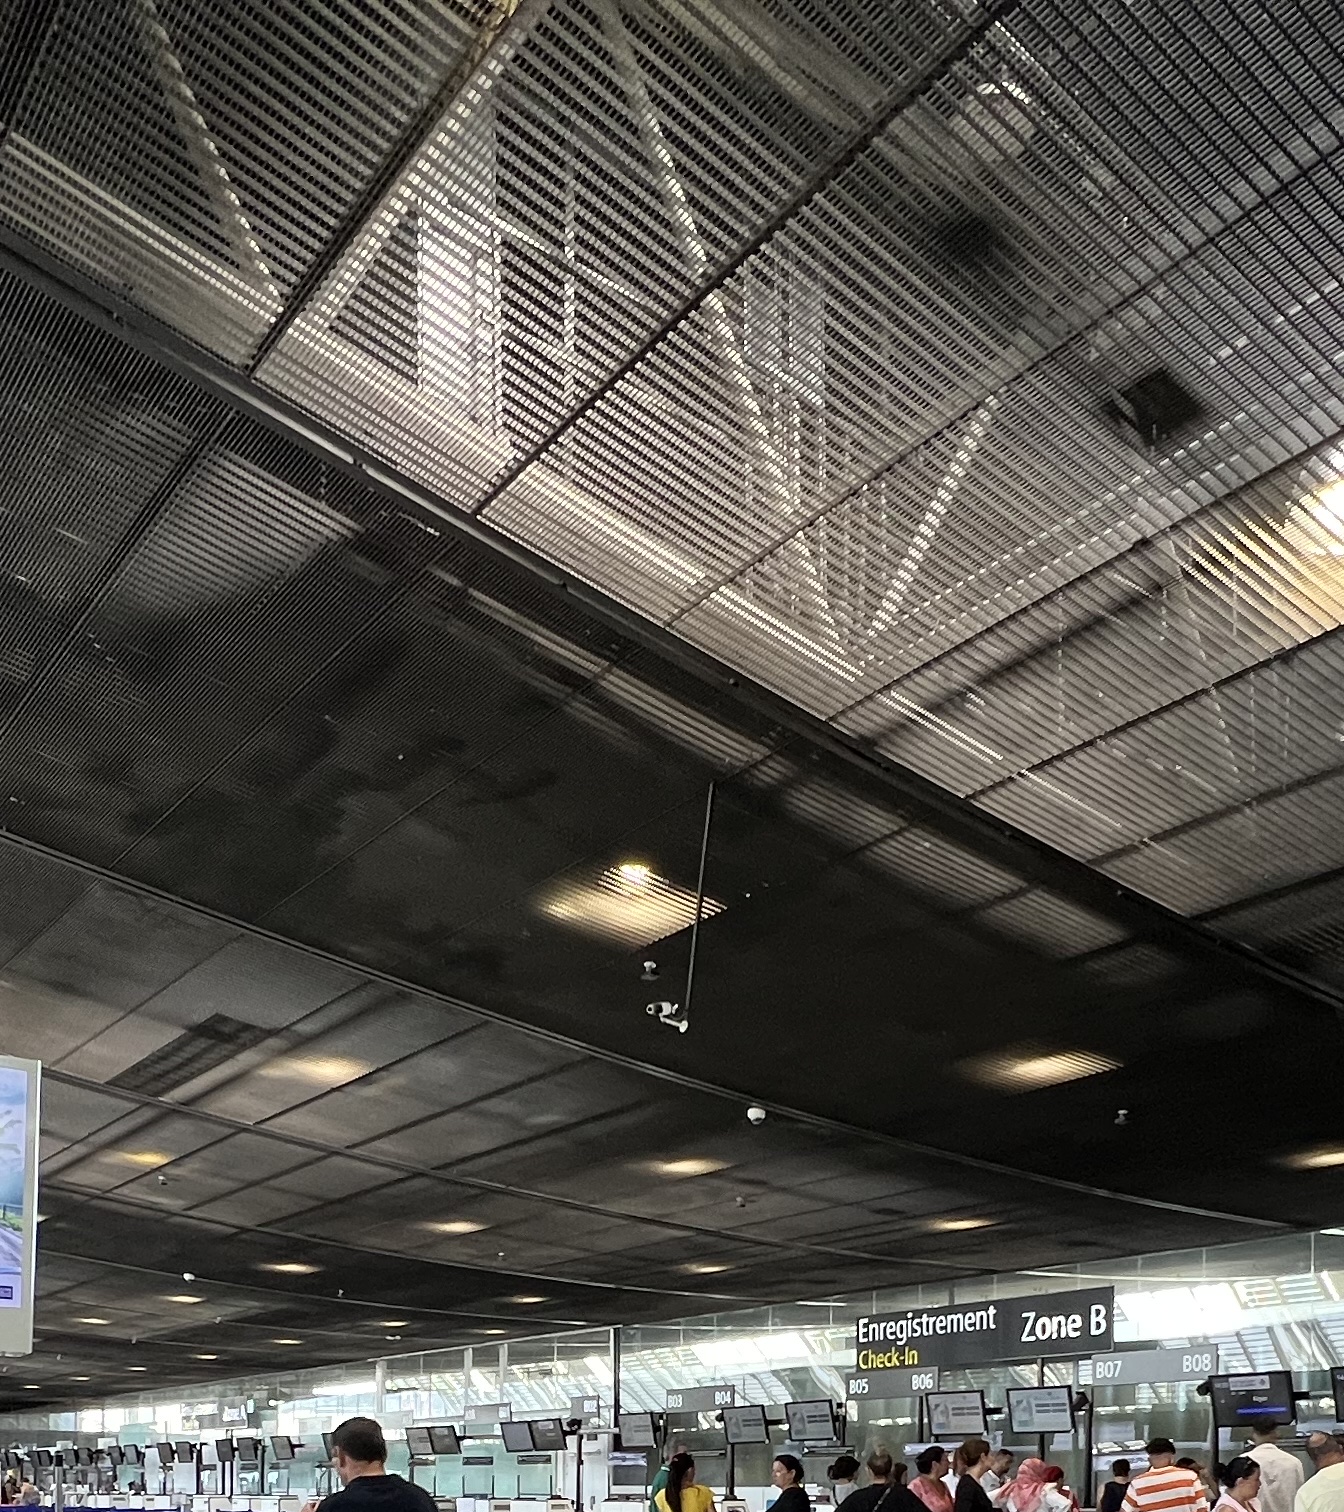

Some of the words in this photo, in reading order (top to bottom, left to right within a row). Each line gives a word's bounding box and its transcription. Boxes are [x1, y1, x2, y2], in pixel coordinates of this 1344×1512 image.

[858, 1304, 998, 1346] Enregistrement
[1020, 1311, 1083, 1342] Zone
[1089, 1303, 1107, 1336] B
[1095, 1360, 1122, 1379] B07
[1182, 1353, 1212, 1373] B08
[849, 1378, 869, 1394] B05
[911, 1373, 934, 1391] B06
[667, 1394, 682, 1408] B03
[714, 1390, 731, 1405] B04
